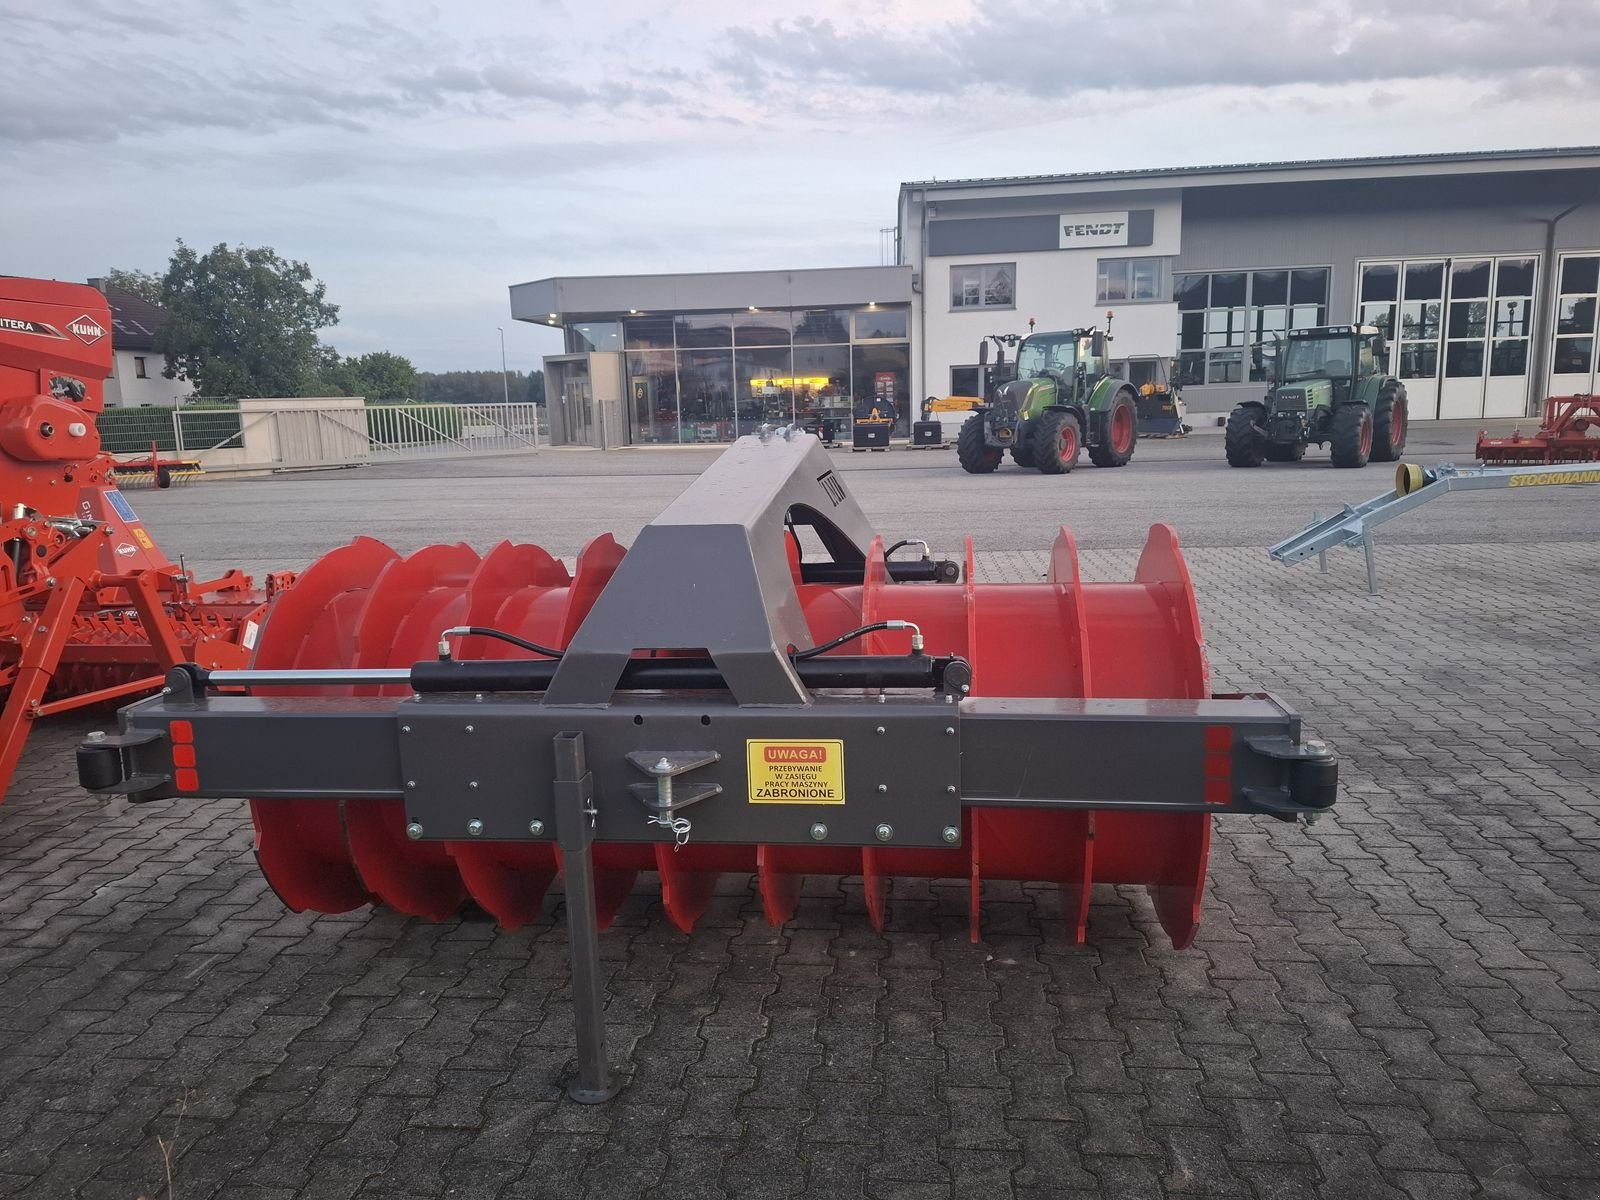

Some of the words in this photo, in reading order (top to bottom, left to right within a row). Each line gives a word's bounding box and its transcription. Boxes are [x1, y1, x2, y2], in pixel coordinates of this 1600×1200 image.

[1063, 222, 1126, 237] FENDT
[72, 323, 101, 337] KUHN
[1509, 472, 1600, 487] STOCKMANN
[768, 749, 823, 760] UWAGA!
[785, 773, 817, 781] ZASIĘGU
[756, 788, 835, 798] ZABRONIONE
